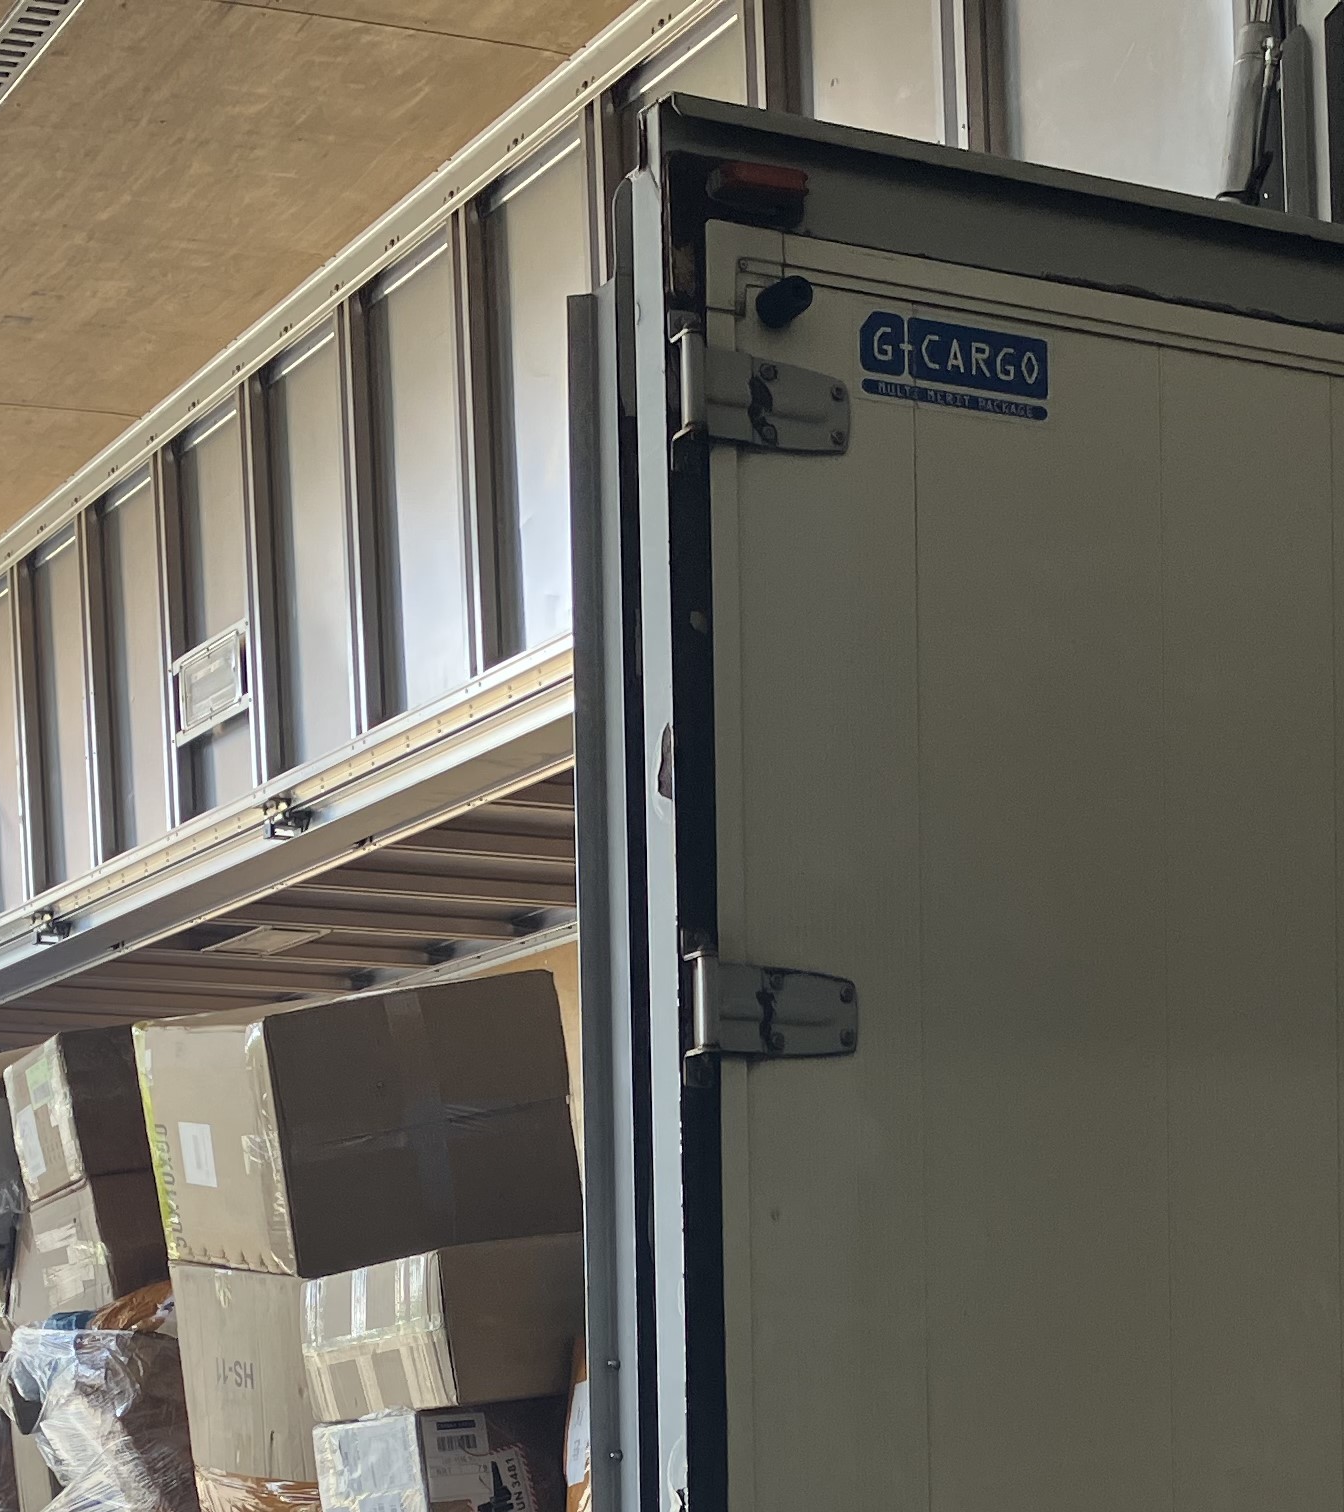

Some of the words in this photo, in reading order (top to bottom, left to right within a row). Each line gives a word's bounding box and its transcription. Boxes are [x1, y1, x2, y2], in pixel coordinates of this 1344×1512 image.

[873, 326, 1040, 385] G-CARGO
[926, 389, 969, 408] MERIT
[978, 394, 1034, 419] PACKAGE
[215, 1357, 255, 1390] HS-11
[505, 1457, 521, 1489] 3481
[514, 1491, 526, 1511] UN
